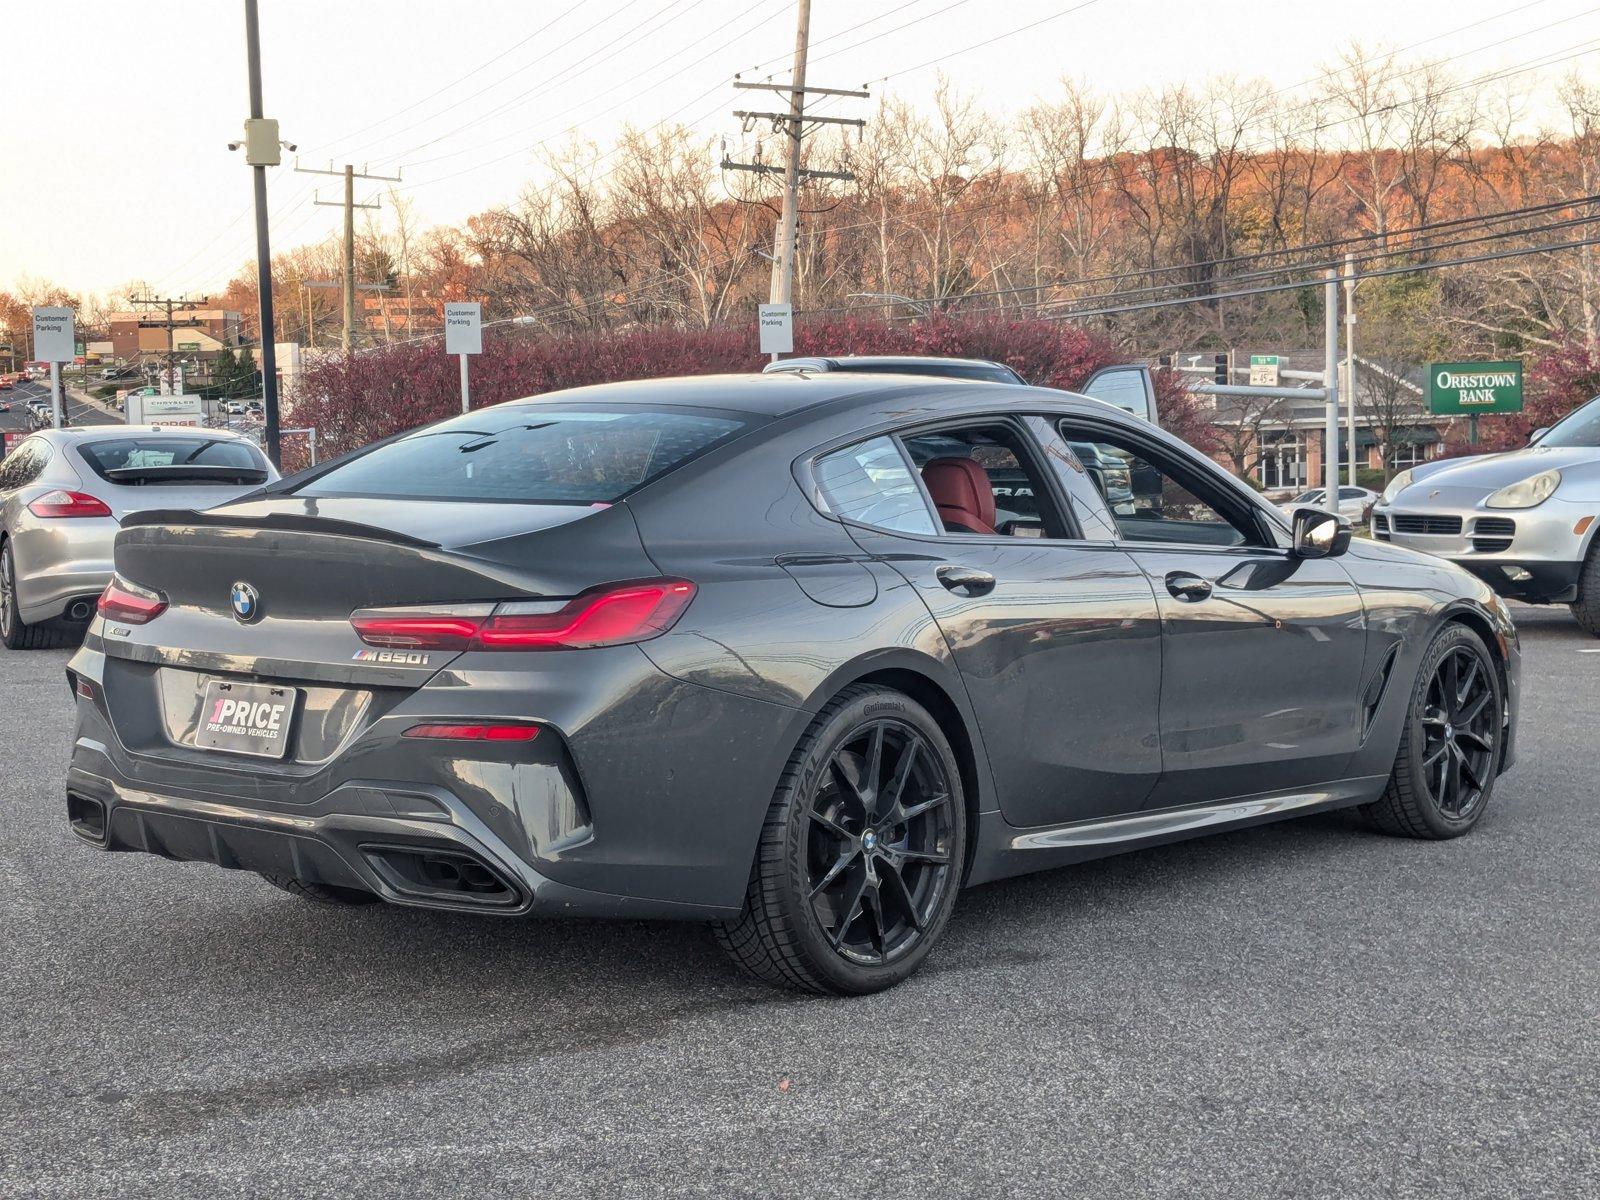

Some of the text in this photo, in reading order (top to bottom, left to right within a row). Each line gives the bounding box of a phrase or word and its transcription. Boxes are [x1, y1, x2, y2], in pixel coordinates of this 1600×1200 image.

[36, 324, 62, 332] Parking
[1436, 371, 1516, 389] ORRSTOWN
[1459, 389, 1496, 402] BANK
[991, 487, 1034, 497] RA
[206, 722, 279, 739] PRE-OWNED VEHICLES
